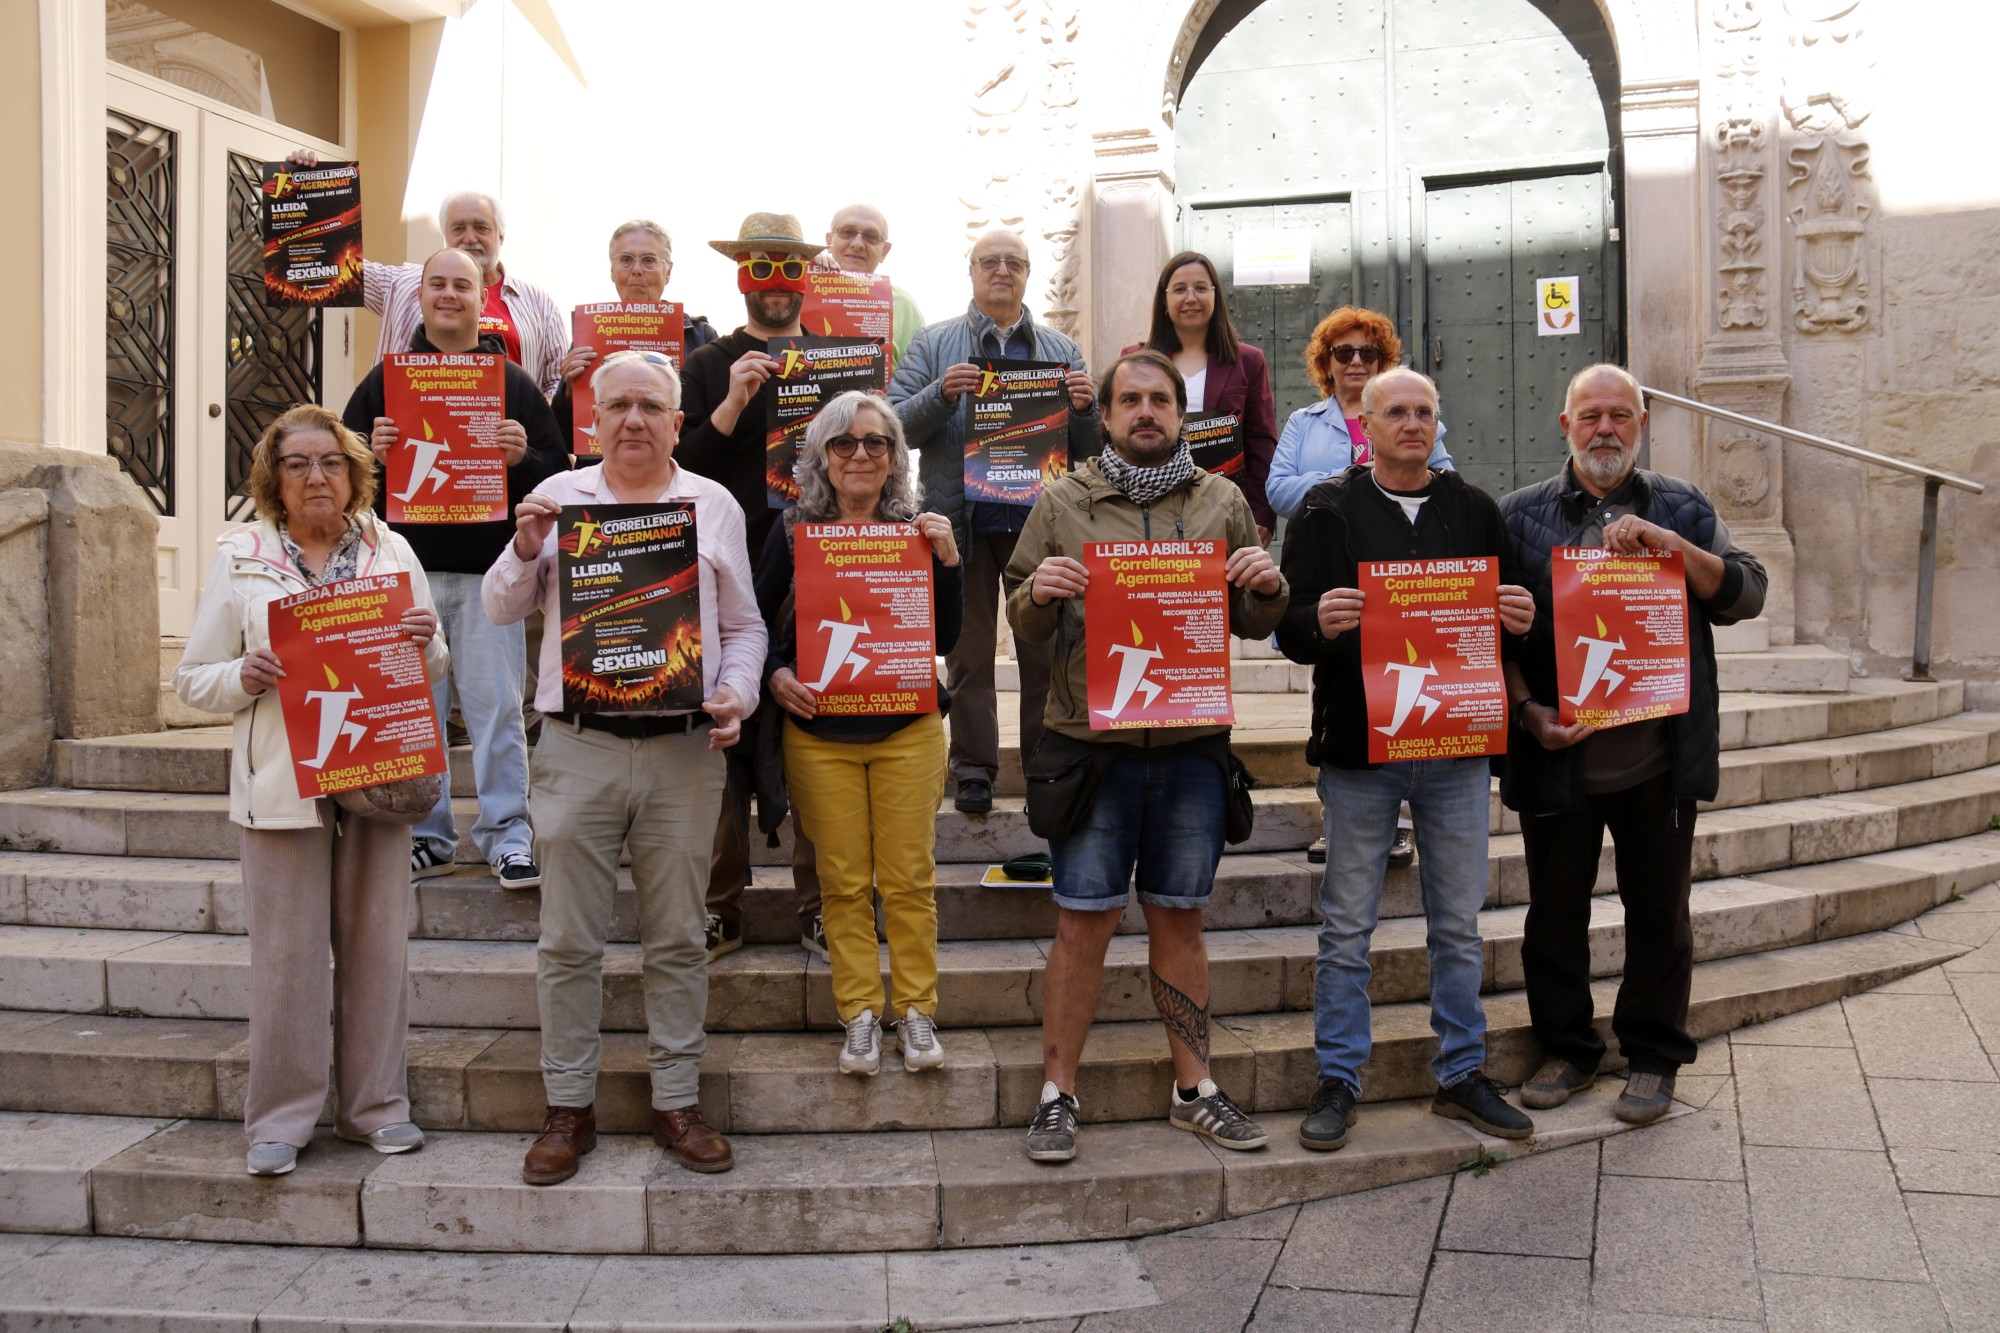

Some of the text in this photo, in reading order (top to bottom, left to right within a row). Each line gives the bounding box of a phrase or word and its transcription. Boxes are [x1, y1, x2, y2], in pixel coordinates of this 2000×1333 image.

[294, 168, 354, 182] CORRELLENGUA
[300, 178, 351, 190] AGERMANAT
[271, 202, 308, 213] LLEIDA
[287, 265, 338, 280] SEXENNI
[811, 275, 874, 286] Correllengua
[814, 285, 870, 295] Agermanat
[584, 304, 674, 314] LLEIDA ABRIL'26
[594, 315, 664, 326] Correllengua
[597, 325, 658, 335] Agermanat
[807, 346, 879, 359] CORRELLENGUA
[394, 355, 494, 366] LLEIDA ABRIL'26
[814, 356, 874, 369] AGERMANAT
[406, 368, 483, 379] Correllengua
[818, 372, 842, 380] LLENGUA
[855, 368, 874, 376] UNEIX!
[1002, 370, 1064, 382] CORRELLENGUA
[411, 379, 477, 391] Agermanat
[778, 384, 821, 396] LLEIDA
[1007, 380, 1059, 390] AGERMANAT
[975, 402, 1012, 412] LLEIDA
[988, 434, 1004, 443] FLAMA
[1005, 429, 1023, 438] ARRIBA
[1028, 424, 1046, 432] LLEIDA
[987, 469, 1040, 480] SEXENNI
[403, 505, 492, 513] LLENGUA CULTURA
[603, 512, 688, 535] CORRELLENGUA
[612, 525, 683, 545] AGERMANAT
[806, 526, 857, 538] LLEIDA
[608, 540, 685, 558] LA LLENGUA ENS UNEIX!
[820, 539, 907, 553] Correllengua
[1096, 542, 1214, 557] LLEIDA ABRIL'26
[825, 553, 901, 566] Agermanat
[1564, 549, 1611, 560] LLEIDA
[571, 562, 623, 577] LLEIDA
[1110, 557, 1201, 572] Correllengua
[1371, 560, 1487, 576] LLEIDA ABRIL'26
[1576, 559, 1660, 572] Correllengua
[585, 576, 621, 585] D'ABRIL
[1115, 571, 1195, 587] Agermanat
[1385, 576, 1475, 591] Correllengua
[1581, 572, 1654, 585] Agermanat
[280, 575, 398, 609] LLEIDA ABRIL'26
[1390, 589, 1468, 606] Agermanat
[293, 592, 388, 618] Correllengua
[592, 605, 614, 616] FLAMA
[615, 597, 640, 609] ARRIBA
[646, 587, 670, 599] LLEIDA
[300, 607, 383, 631] Agermanat
[598, 646, 631, 655] CONCERT
[592, 649, 667, 673] SEXENNI
[817, 693, 919, 704] LLENGUA CULTURA
[859, 703, 916, 712] CATALANS
[1575, 703, 1671, 718] LLENGUA CULTURA
[1467, 723, 1502, 732] SEXENNI
[1387, 734, 1489, 750] LLENGUA CULTURA
[1429, 744, 1485, 757] CATALANS
[316, 754, 426, 782] LLENGUA CULTURA
[363, 765, 424, 786] CATALANS
